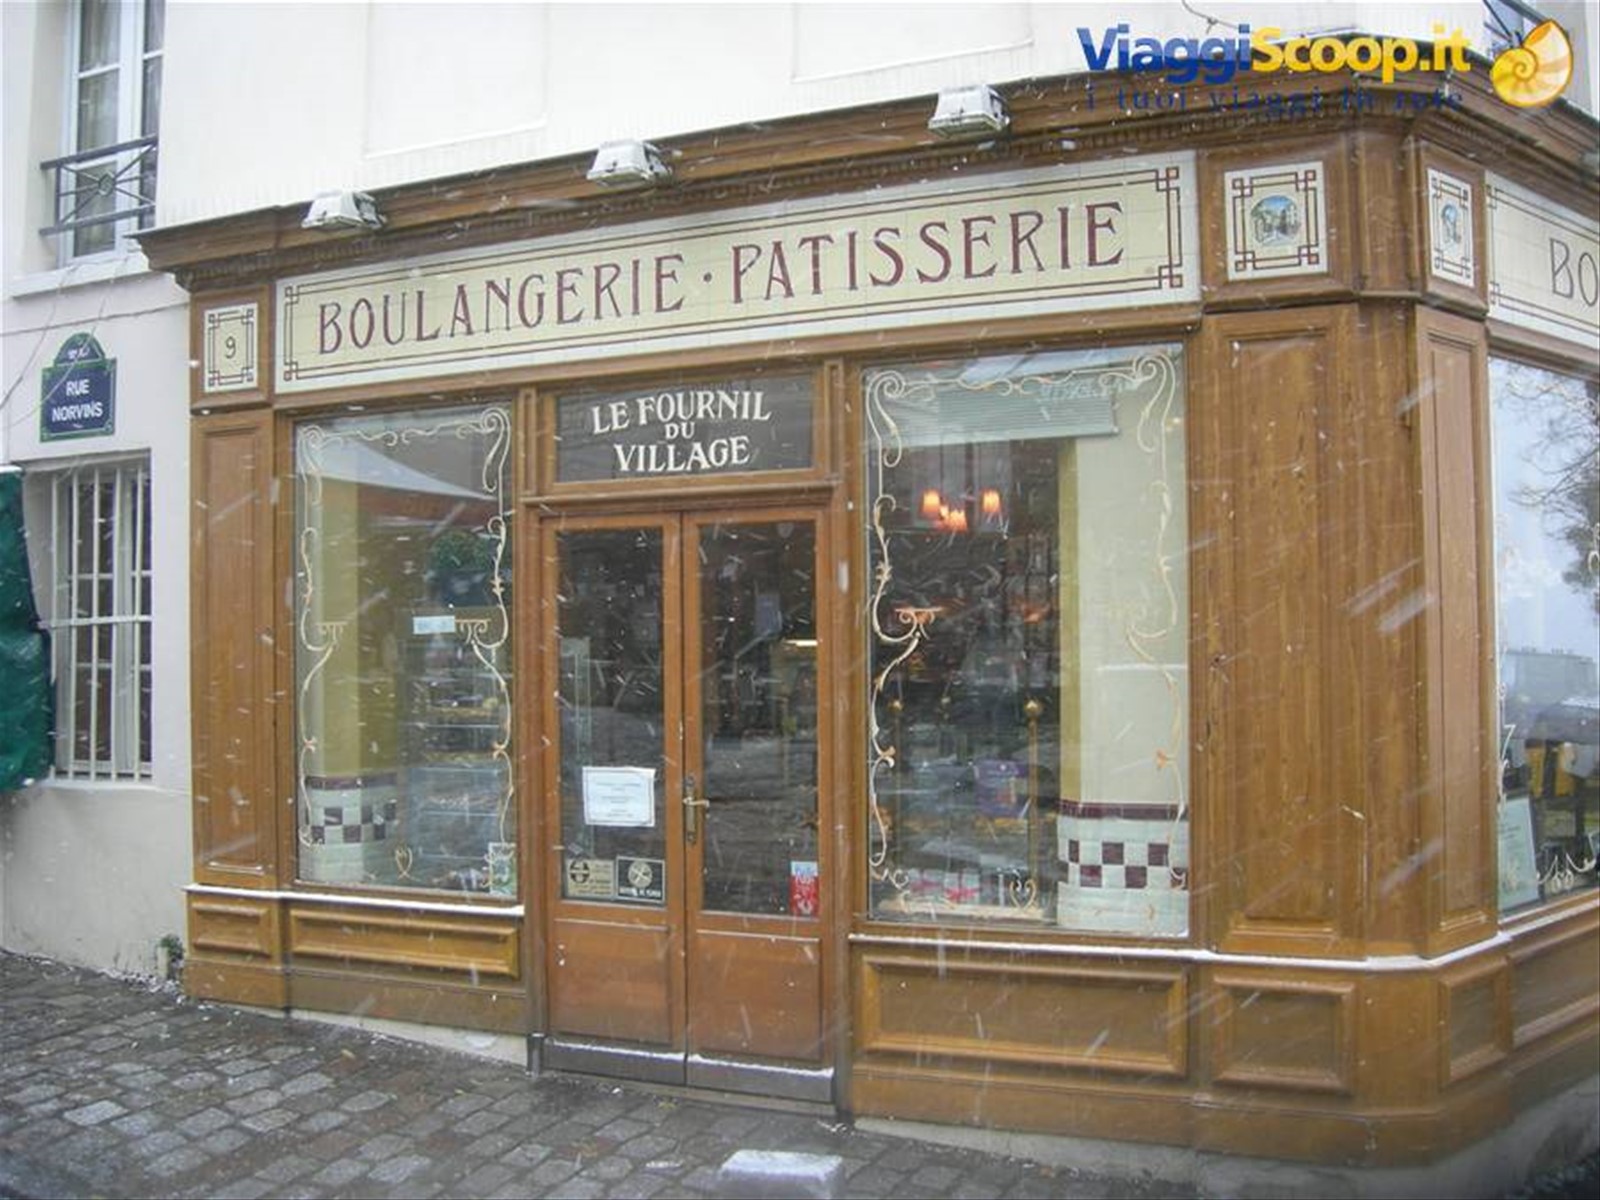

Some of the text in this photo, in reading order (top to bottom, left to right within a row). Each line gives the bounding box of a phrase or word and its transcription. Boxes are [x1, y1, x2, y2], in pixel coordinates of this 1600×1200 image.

[318, 200, 1125, 355] BOULANGERIE PATISSERIE
[225, 336, 237, 359] 9
[66, 379, 90, 397] RUE
[51, 401, 104, 422] NORVINS
[591, 389, 772, 435] LE FOURNIL
[664, 421, 696, 440] DU
[613, 435, 751, 473] VILLAGE
